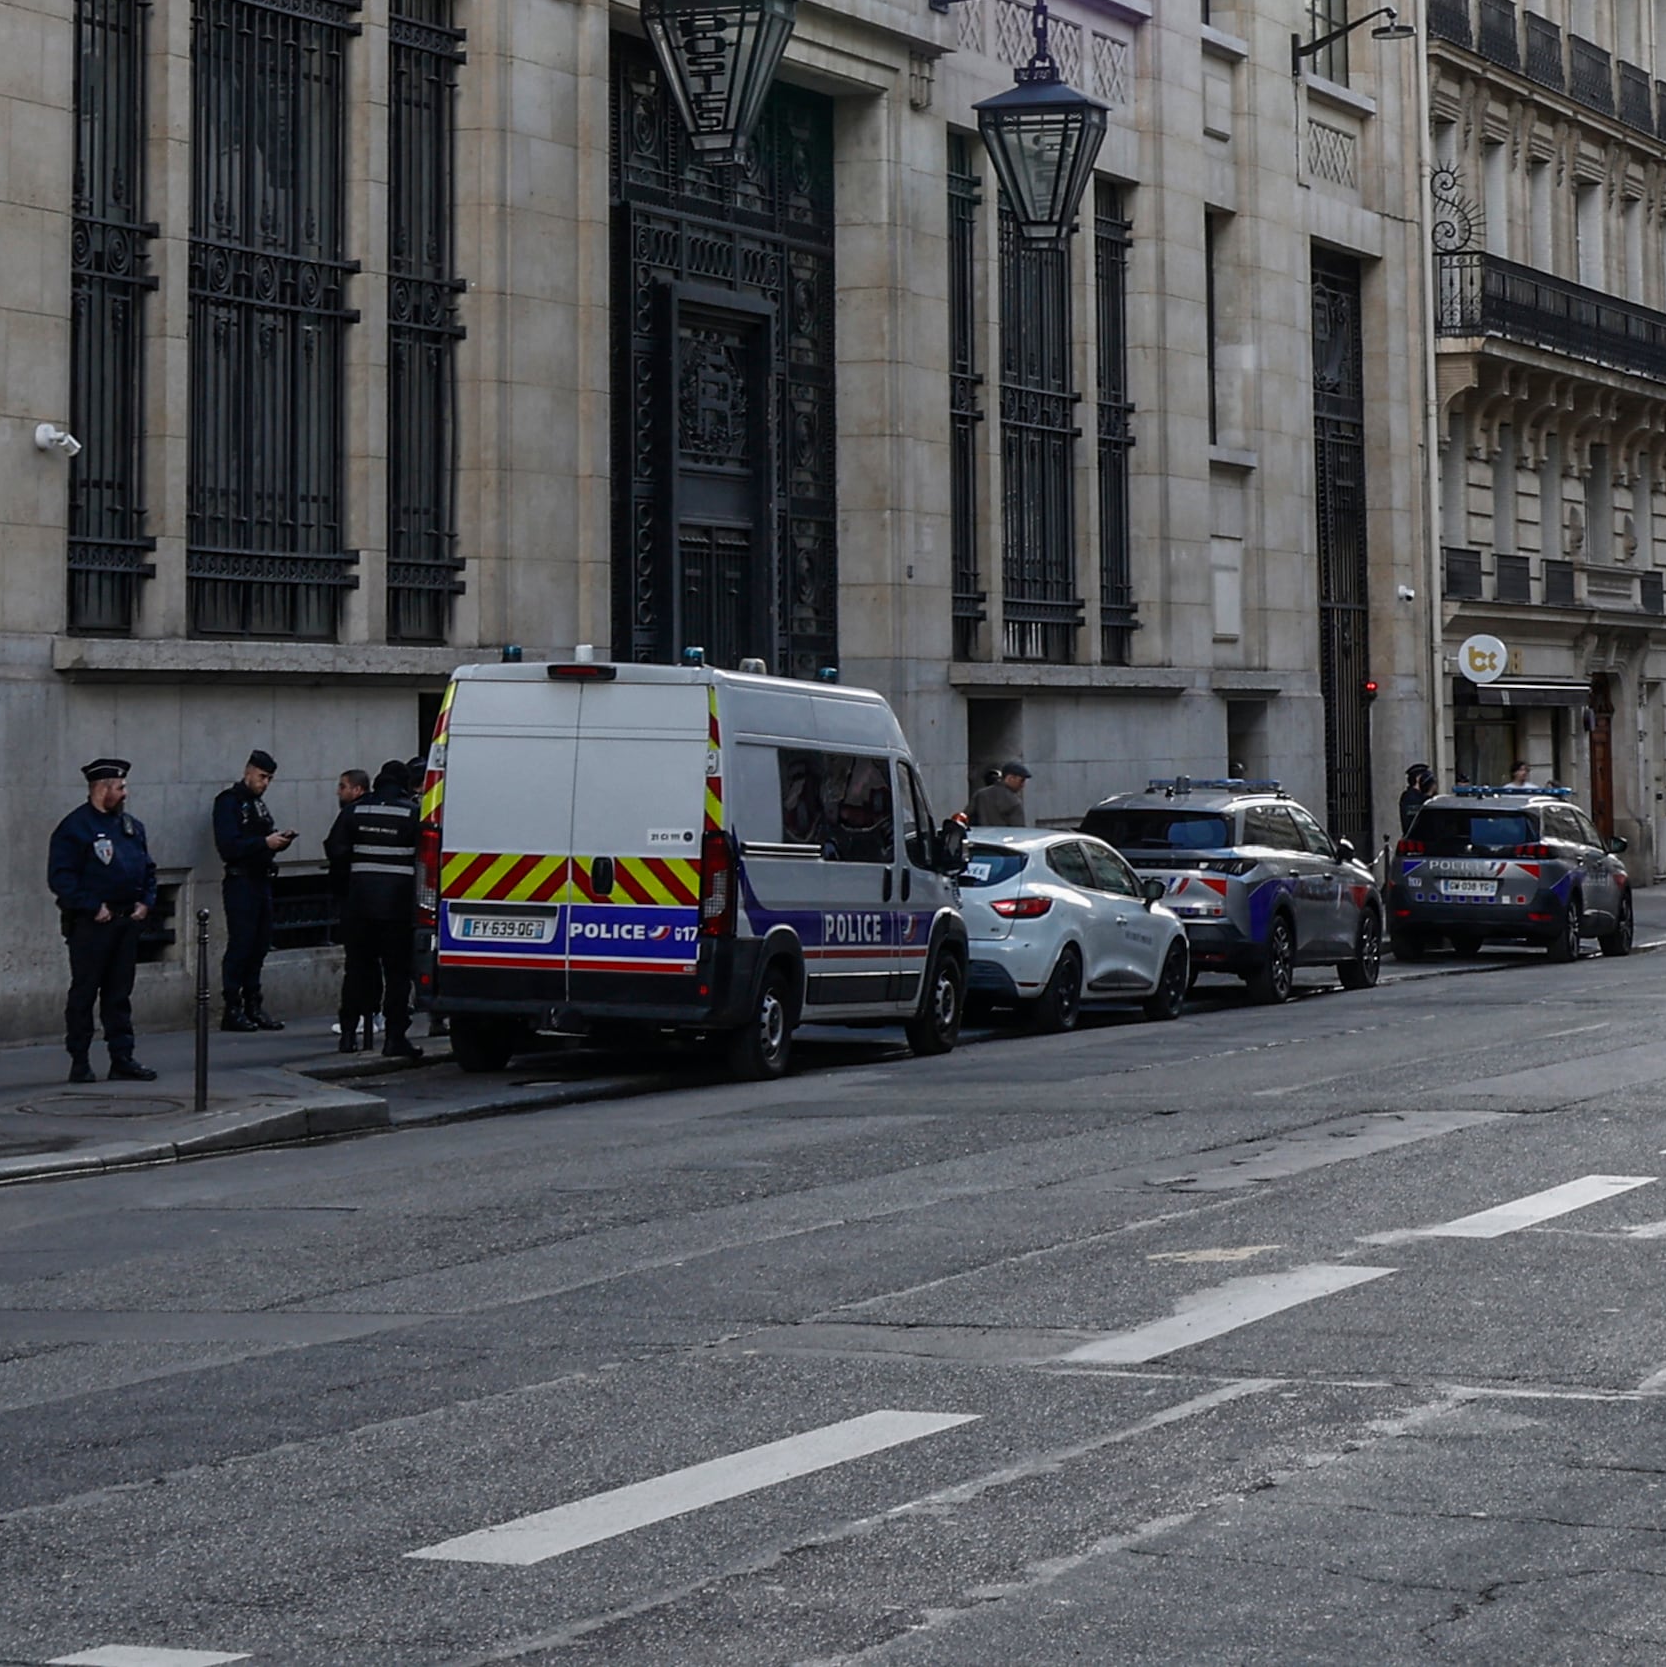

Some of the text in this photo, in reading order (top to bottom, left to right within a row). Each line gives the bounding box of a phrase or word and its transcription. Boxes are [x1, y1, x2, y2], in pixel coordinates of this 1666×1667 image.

[569, 922, 699, 942] POLICE 17
[824, 914, 882, 943] POLICE
